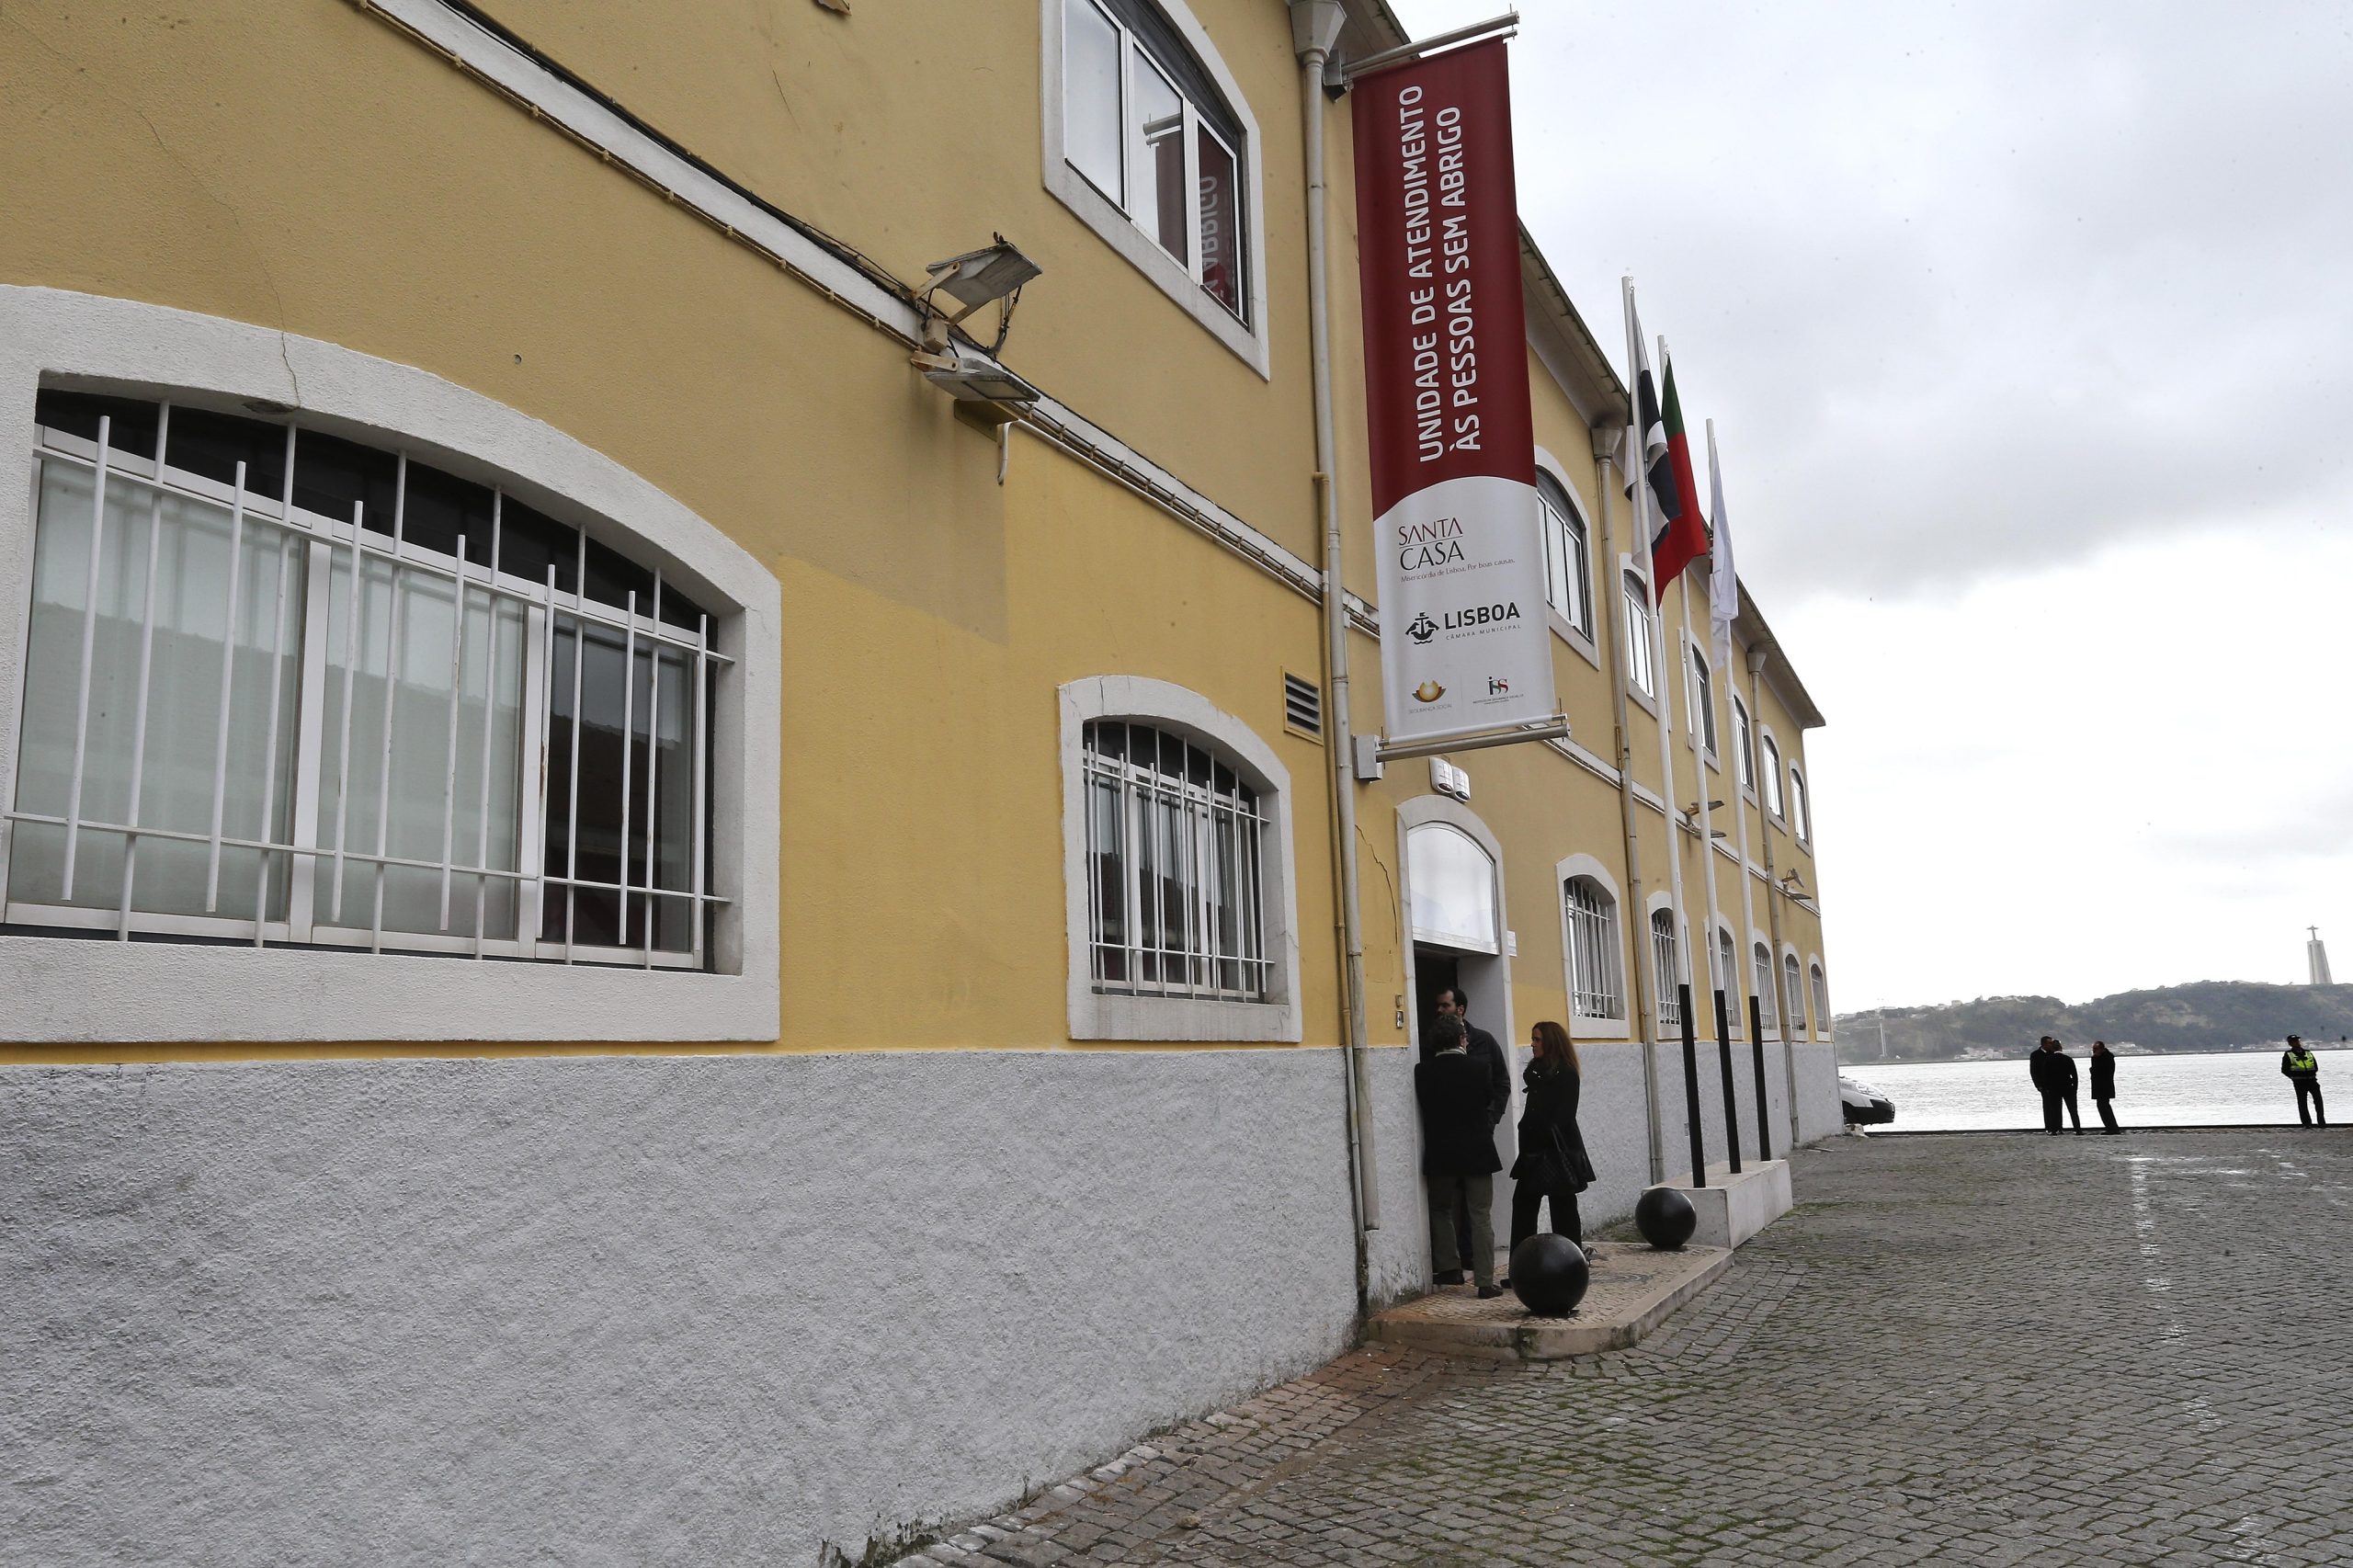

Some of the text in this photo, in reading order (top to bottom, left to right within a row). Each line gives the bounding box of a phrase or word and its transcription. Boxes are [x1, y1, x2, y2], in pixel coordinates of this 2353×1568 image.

[1399, 85, 1443, 461] UNIDADE DE ATENDIMENTO
[1437, 107, 1481, 451] ÀS PESSOAS SEM ABRIGO
[1398, 517, 1463, 546] SANTA
[1400, 540, 1465, 571] CASA
[1445, 602, 1520, 630] LISBOA
[1446, 624, 1521, 641] CÂMARA MUNICIPAL
